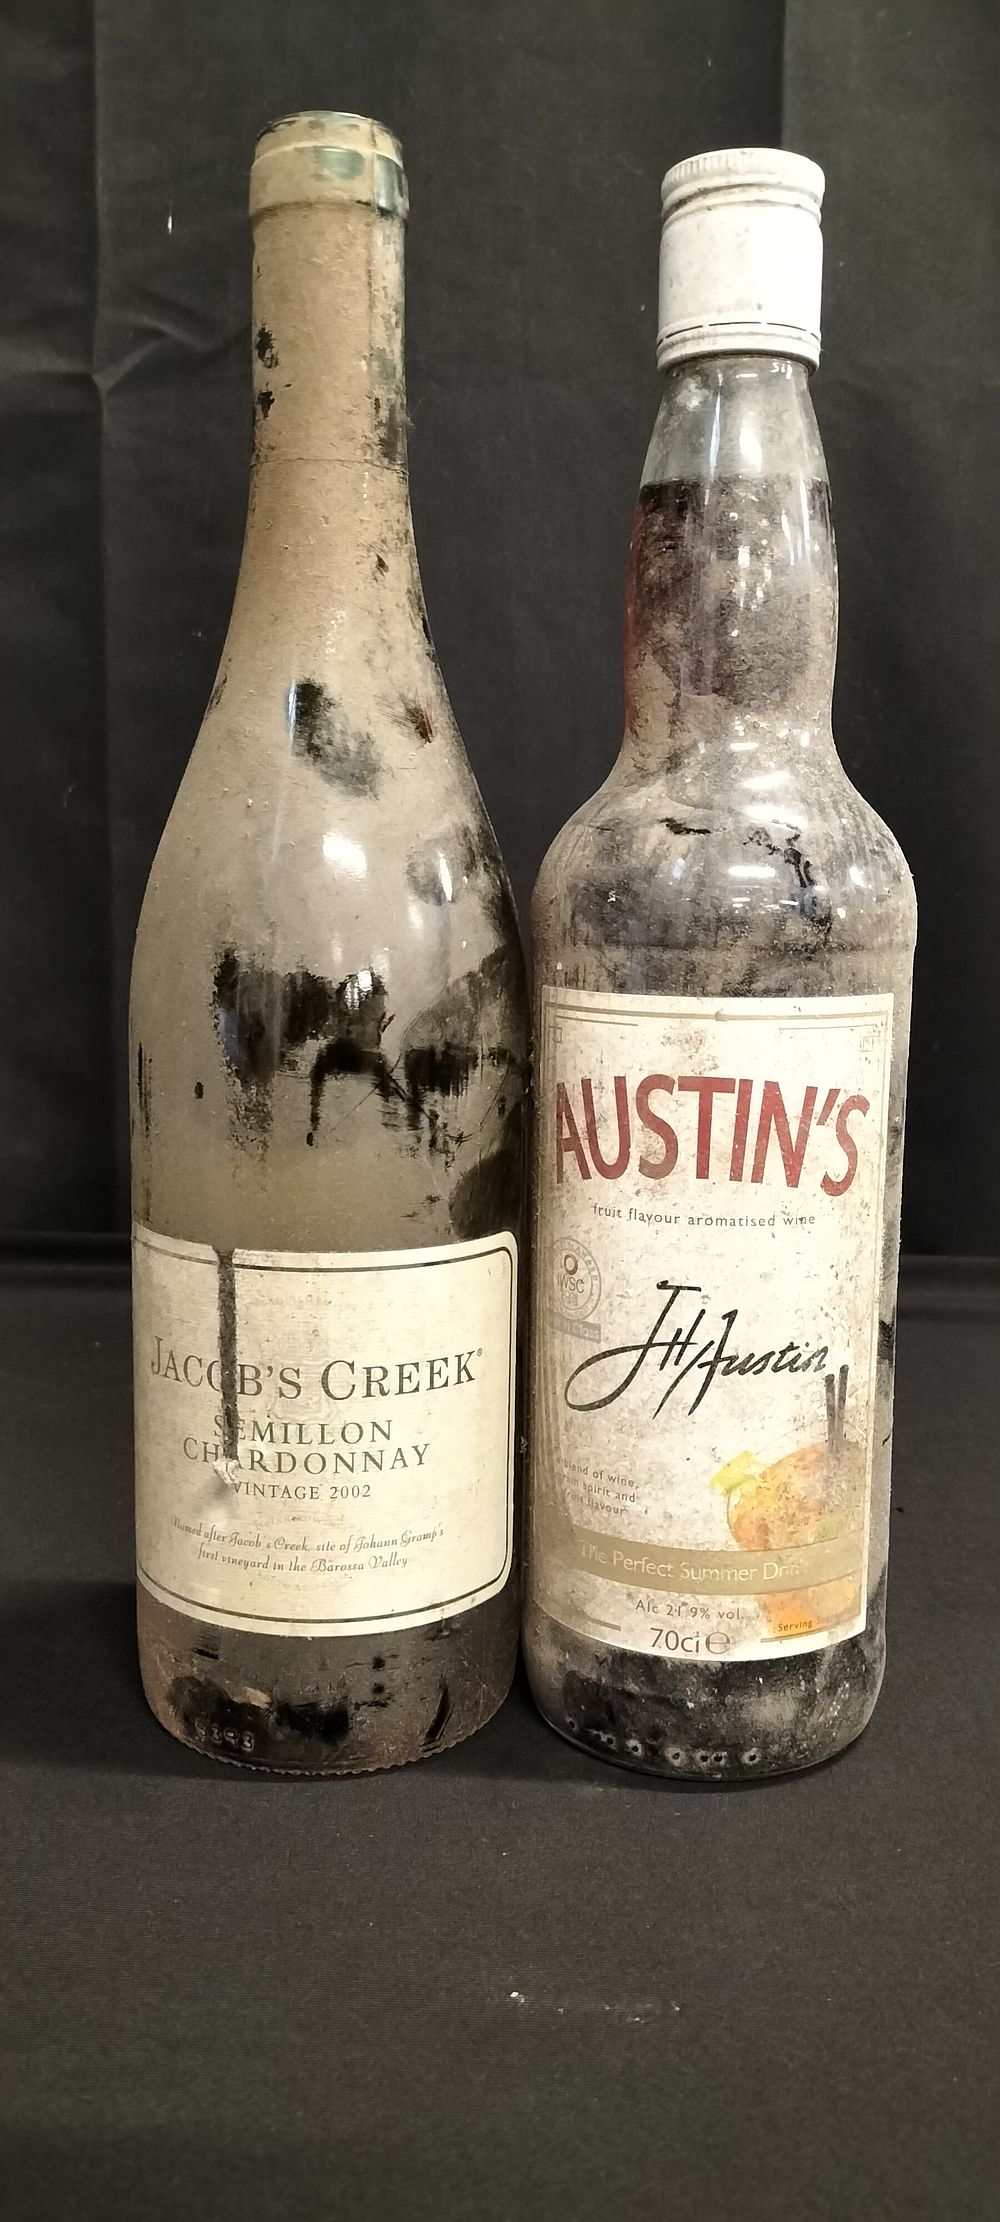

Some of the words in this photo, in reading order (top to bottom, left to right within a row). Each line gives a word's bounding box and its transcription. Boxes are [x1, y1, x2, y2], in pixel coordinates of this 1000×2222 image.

[556, 1073, 870, 1197] AUSTIN'S
[592, 1203, 622, 1219] fruit
[628, 1208, 680, 1227] flavour
[687, 1215, 776, 1227] aromatised
[782, 1215, 816, 1226] wine
[150, 1336, 302, 1400] JACOB'S
[213, 1414, 393, 1445] SEMILLON
[593, 1470, 604, 1480] of
[234, 1481, 320, 1500] VINTAGE
[329, 1484, 371, 1499] 2002
[615, 1491, 636, 1503] and
[203, 1524, 228, 1542] after
[316, 1541, 336, 1552] site
[340, 1534, 354, 1553] of
[353, 1533, 397, 1552] Johann
[400, 1522, 444, 1547] Gramp's
[198, 1542, 219, 1560] first
[222, 1555, 270, 1570] vineyard
[273, 1561, 284, 1571] in
[289, 1556, 306, 1572] the
[310, 1558, 364, 1572] Barossa
[368, 1551, 408, 1569] Valley
[612, 1549, 675, 1578] Perfect
[679, 1562, 757, 1583] Summer
[635, 1599, 659, 1614] Alc
[778, 1620, 813, 1632] Serving
